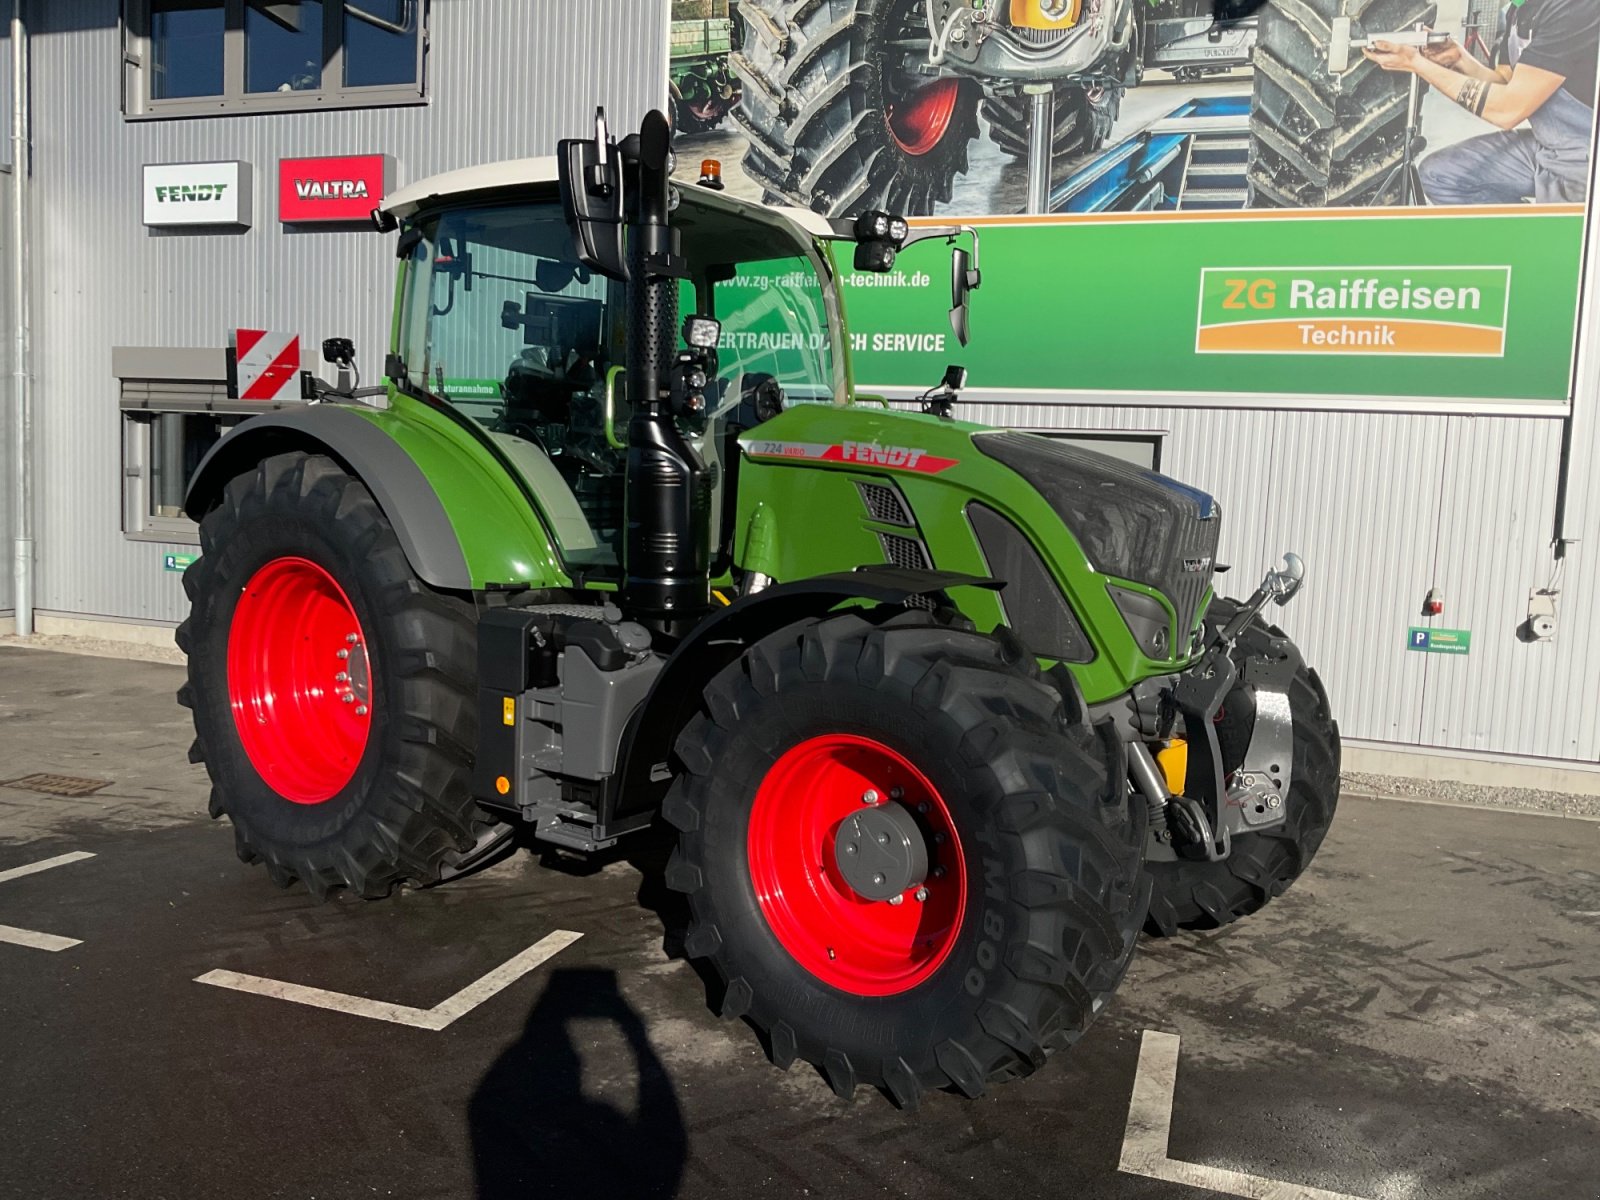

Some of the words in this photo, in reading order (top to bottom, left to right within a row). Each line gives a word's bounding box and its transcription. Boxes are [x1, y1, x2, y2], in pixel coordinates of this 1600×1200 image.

[155, 183, 227, 202] FENDT
[294, 178, 369, 200] VALTRA
[1222, 279, 1276, 309] ZG
[1290, 279, 1481, 309] Raiffeisen
[716, 332, 804, 349] ERTRAUEN
[872, 333, 945, 352] SERVICE
[1298, 325, 1396, 345] Technik
[764, 442, 783, 454] 724
[784, 447, 805, 456] VARIO
[843, 440, 927, 467] FENDT
[1416, 632, 1425, 644] P
